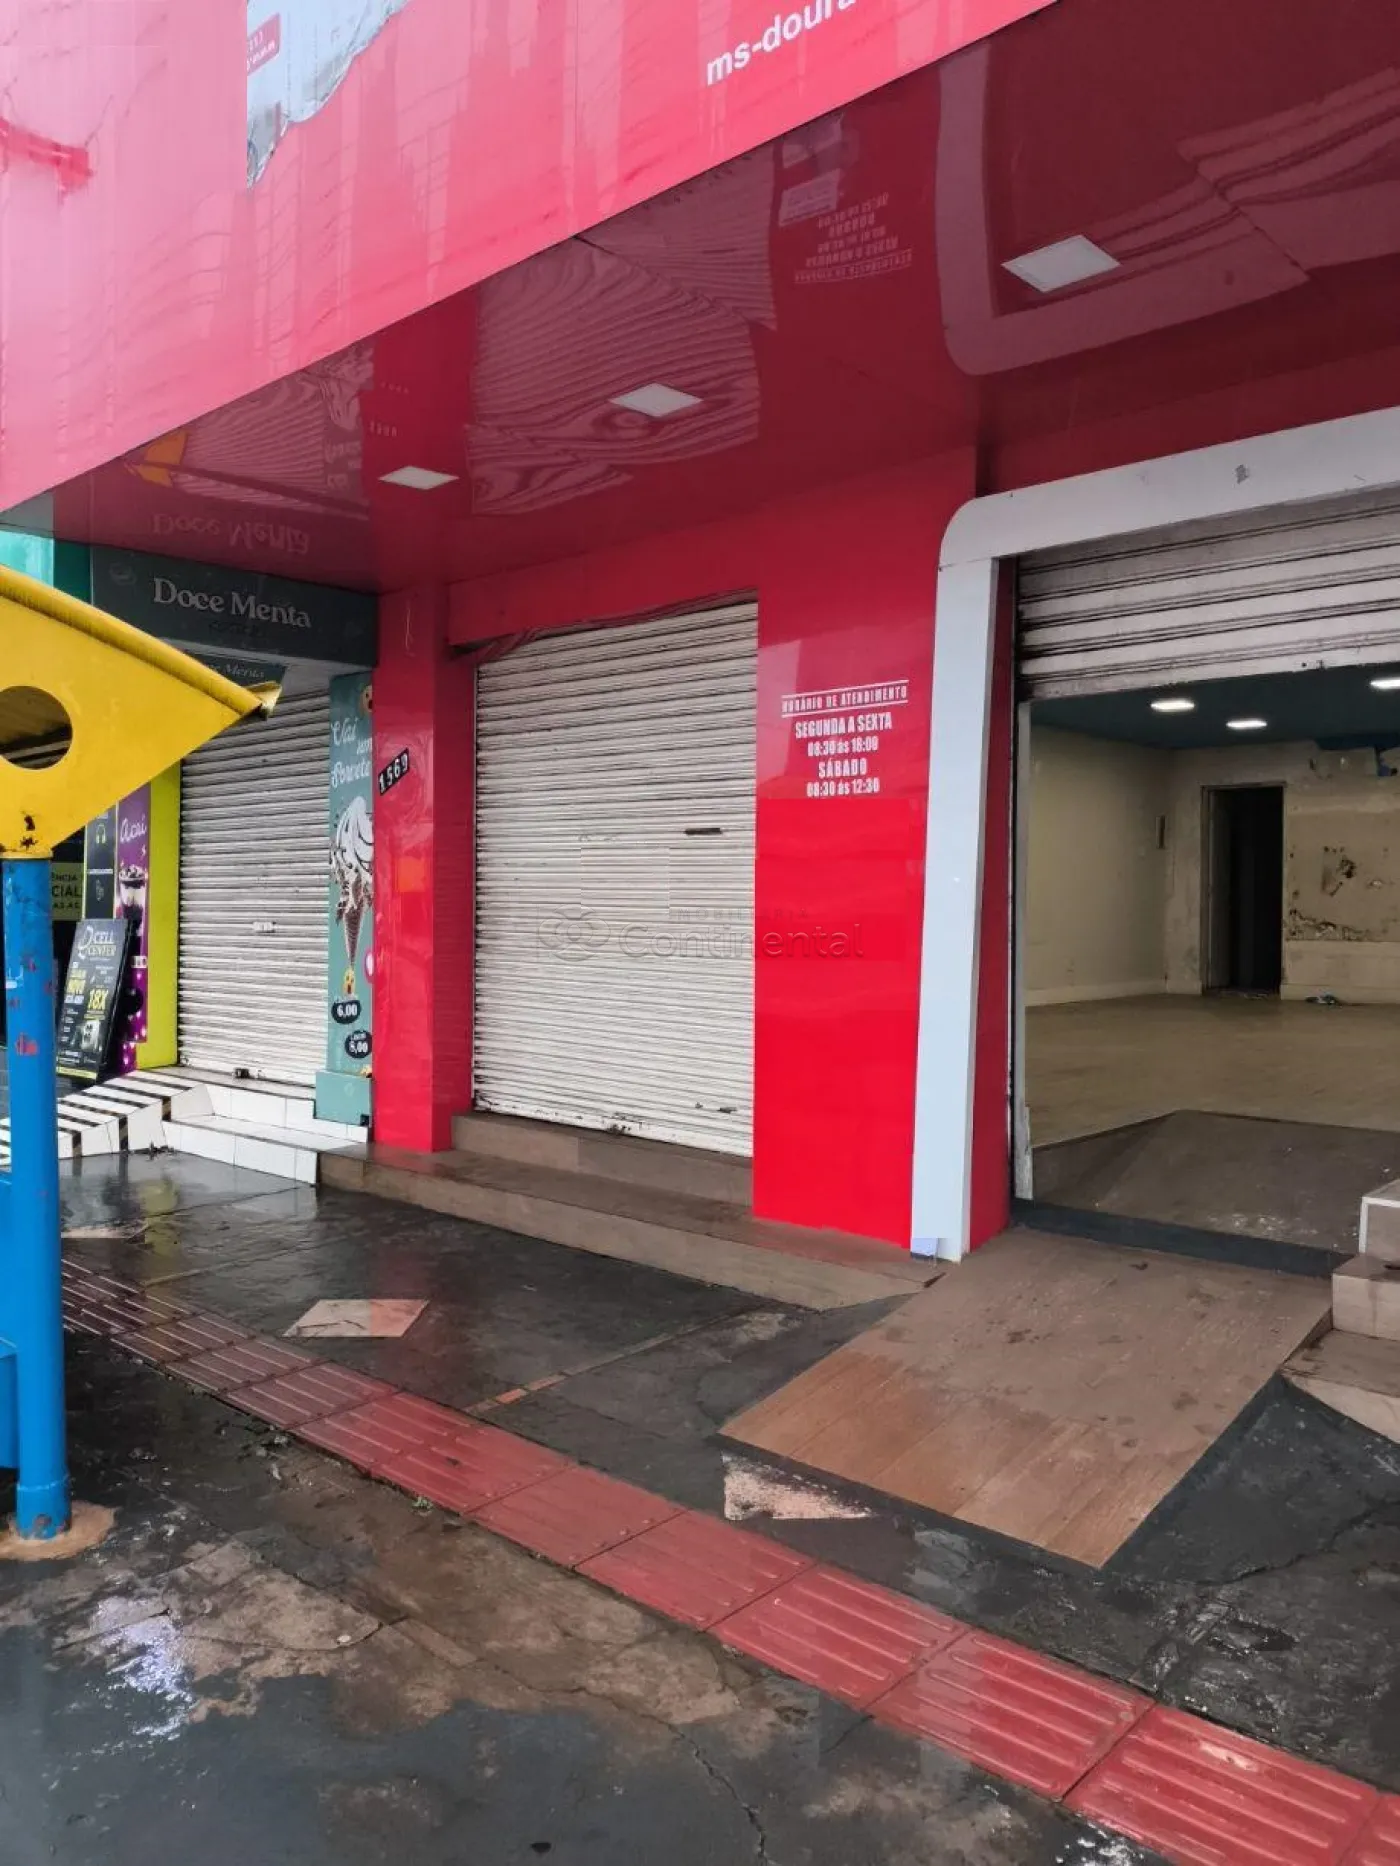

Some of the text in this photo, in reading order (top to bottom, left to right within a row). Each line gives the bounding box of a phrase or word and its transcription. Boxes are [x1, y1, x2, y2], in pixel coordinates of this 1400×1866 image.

[154, 577, 312, 628] Doce Menta
[826, 695, 839, 708] DE
[841, 685, 907, 707] ATENDIMENTO
[795, 712, 893, 739] SEGUNDA A SEXTA
[807, 740, 837, 757] 08:30
[851, 735, 879, 753] 18:00
[818, 757, 868, 779] SÁBADO
[806, 780, 837, 797] 08:30
[851, 776, 880, 794] 12:30
